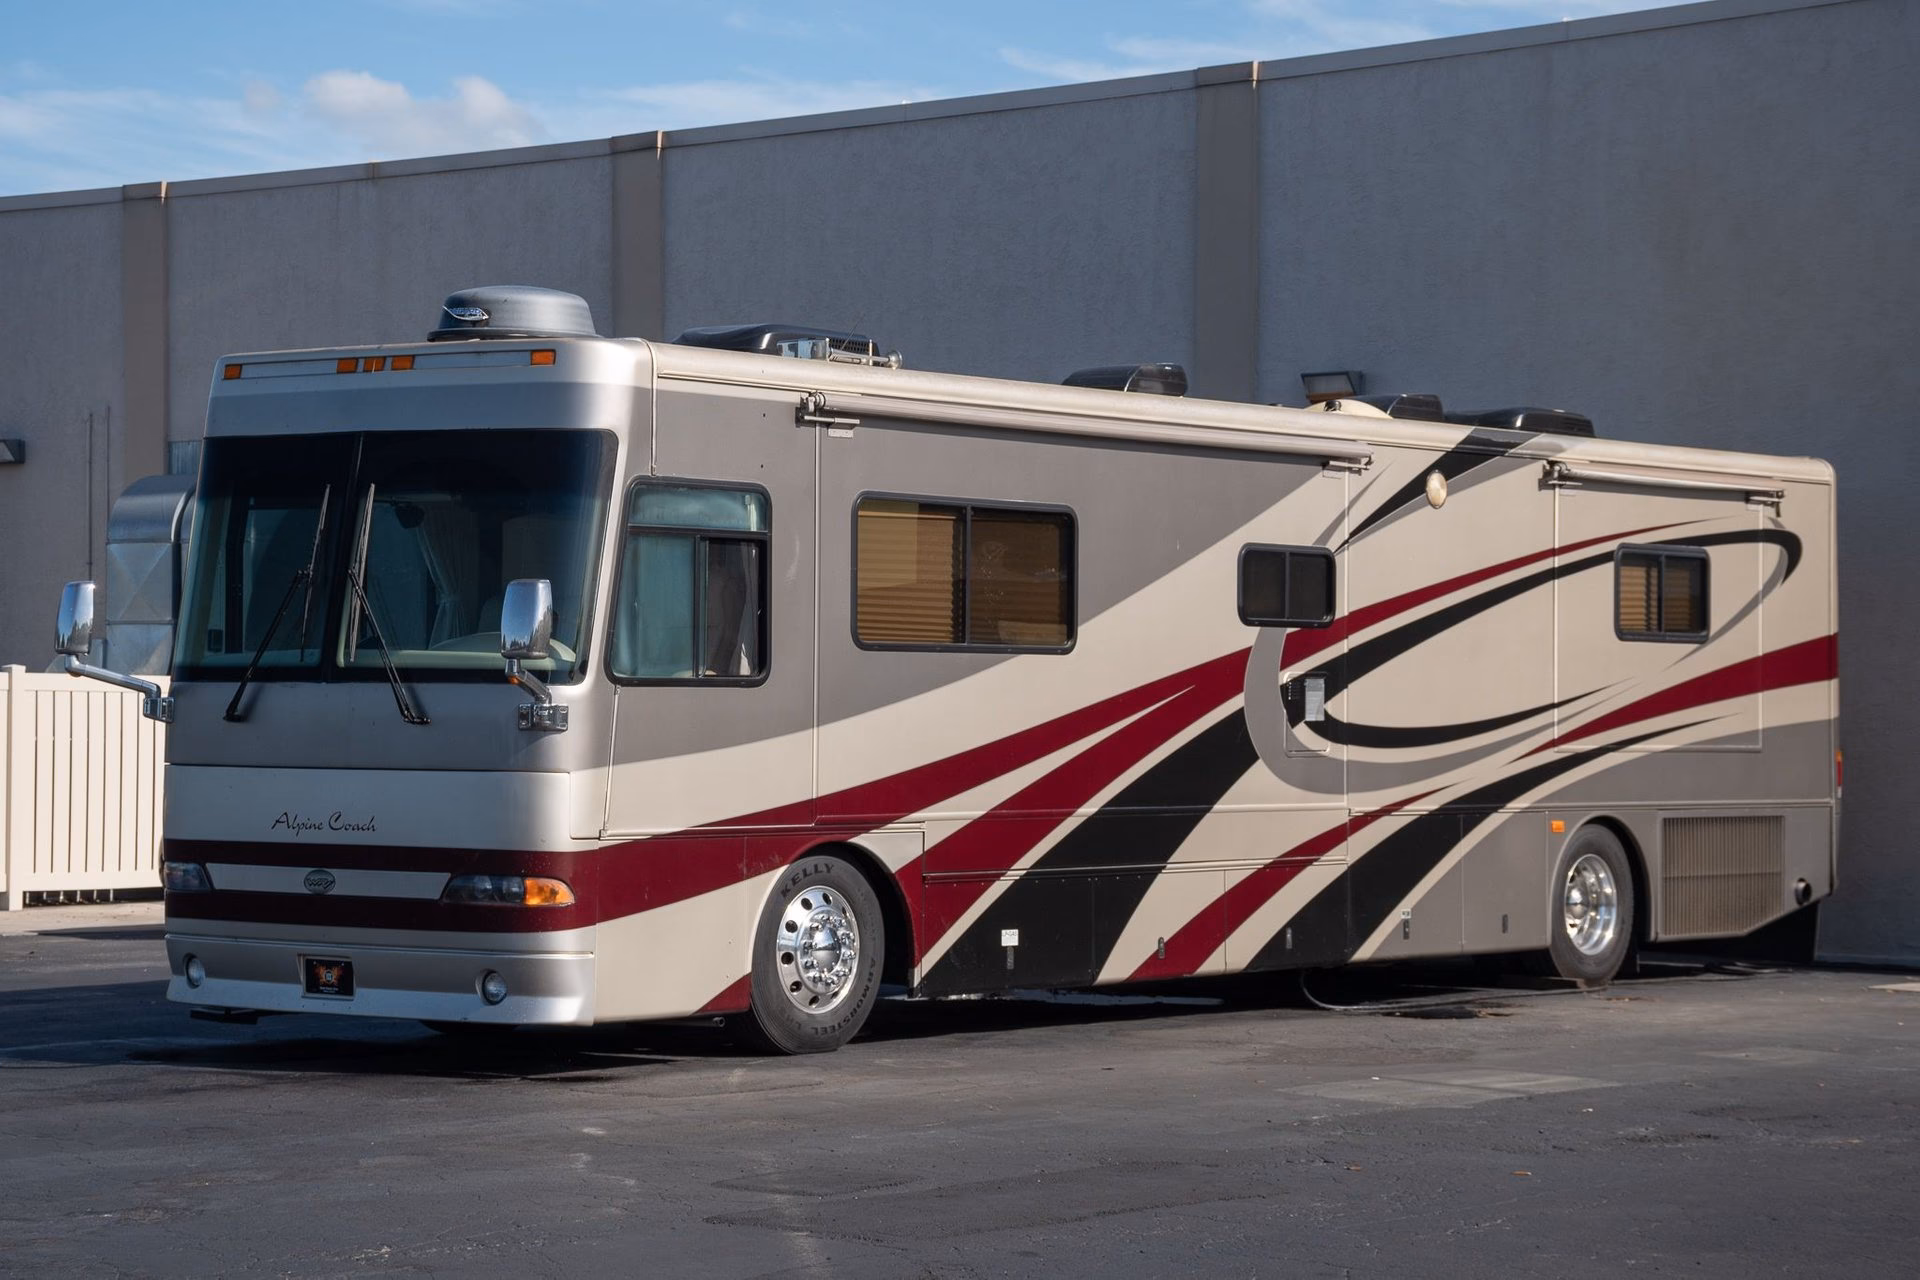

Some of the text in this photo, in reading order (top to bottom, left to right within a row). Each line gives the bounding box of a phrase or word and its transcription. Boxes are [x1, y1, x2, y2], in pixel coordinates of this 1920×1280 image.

[271, 811, 376, 837] Alpine Coach
[781, 863, 834, 898] KELLY
[812, 959, 876, 1035] ARMORSTEEL
